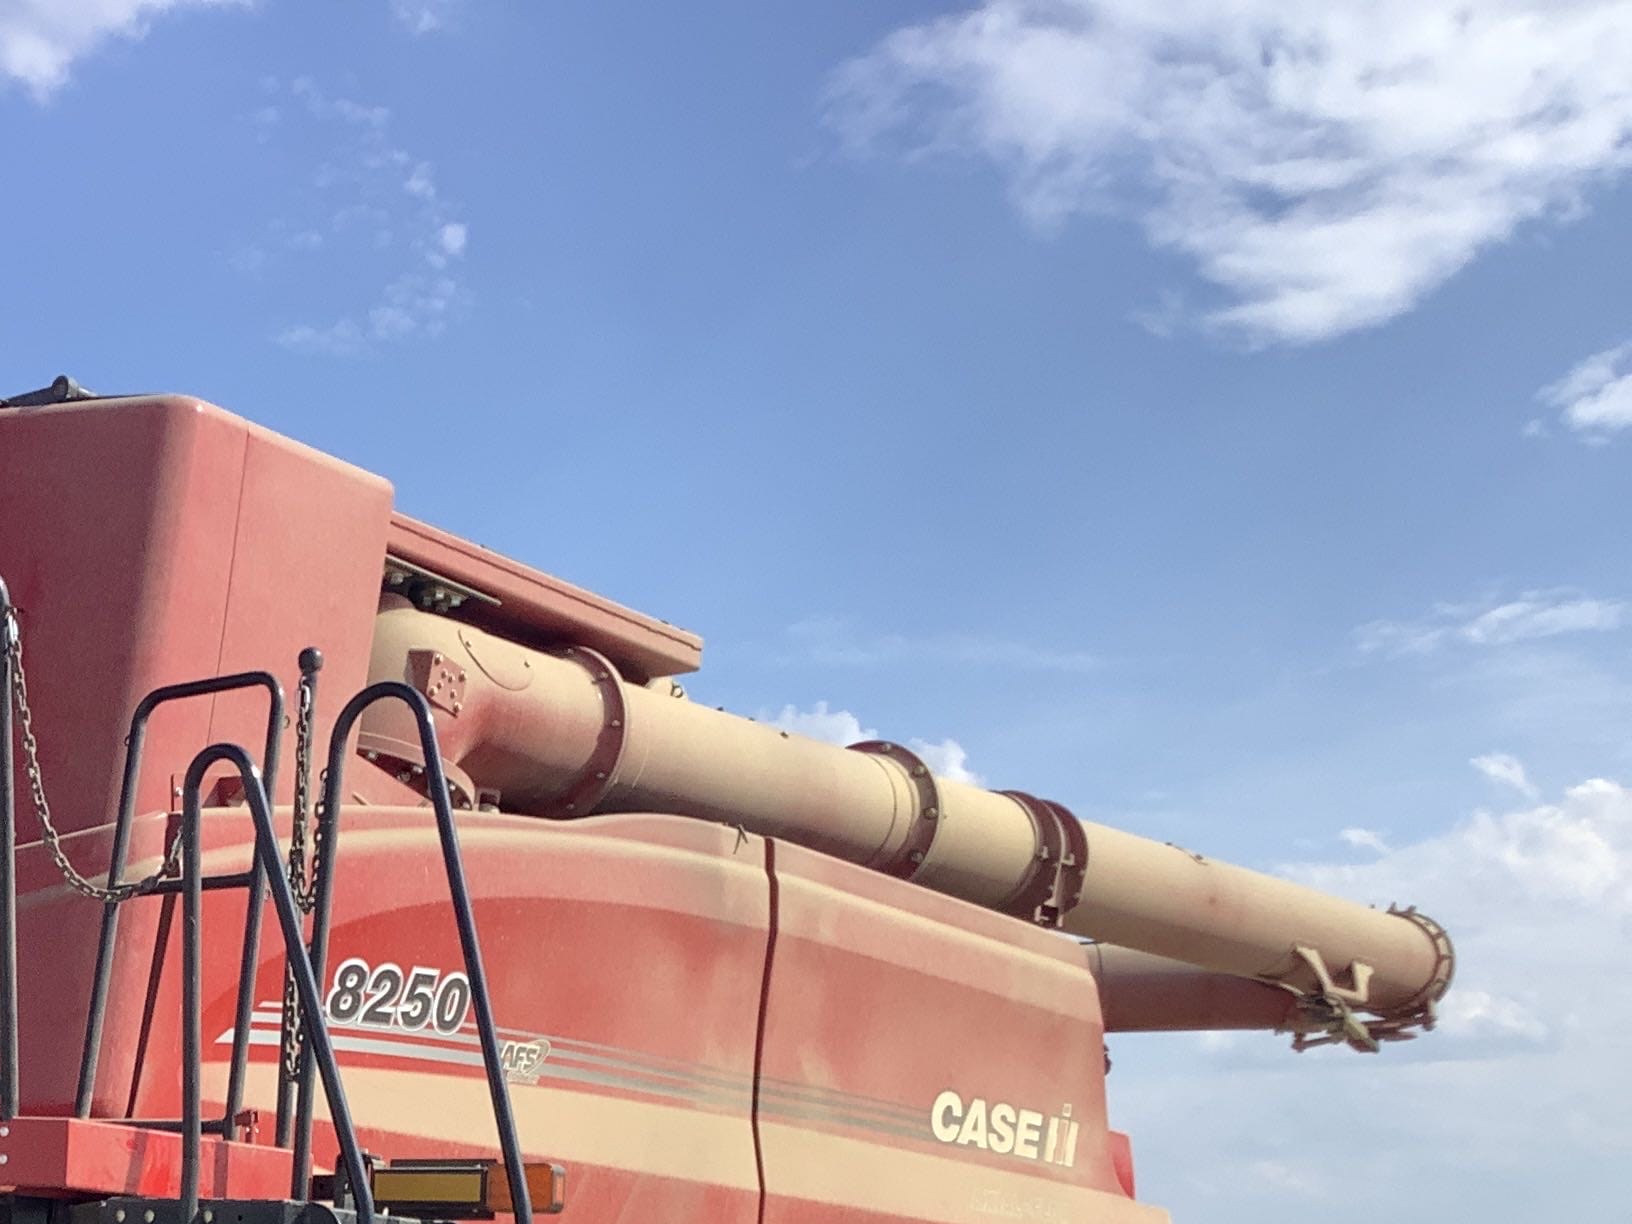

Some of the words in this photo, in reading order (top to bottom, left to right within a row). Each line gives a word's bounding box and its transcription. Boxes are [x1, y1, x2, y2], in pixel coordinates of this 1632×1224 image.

[325, 957, 471, 1036] 8250
[500, 1040, 540, 1072] AFS
[930, 1090, 1043, 1160] CASE
